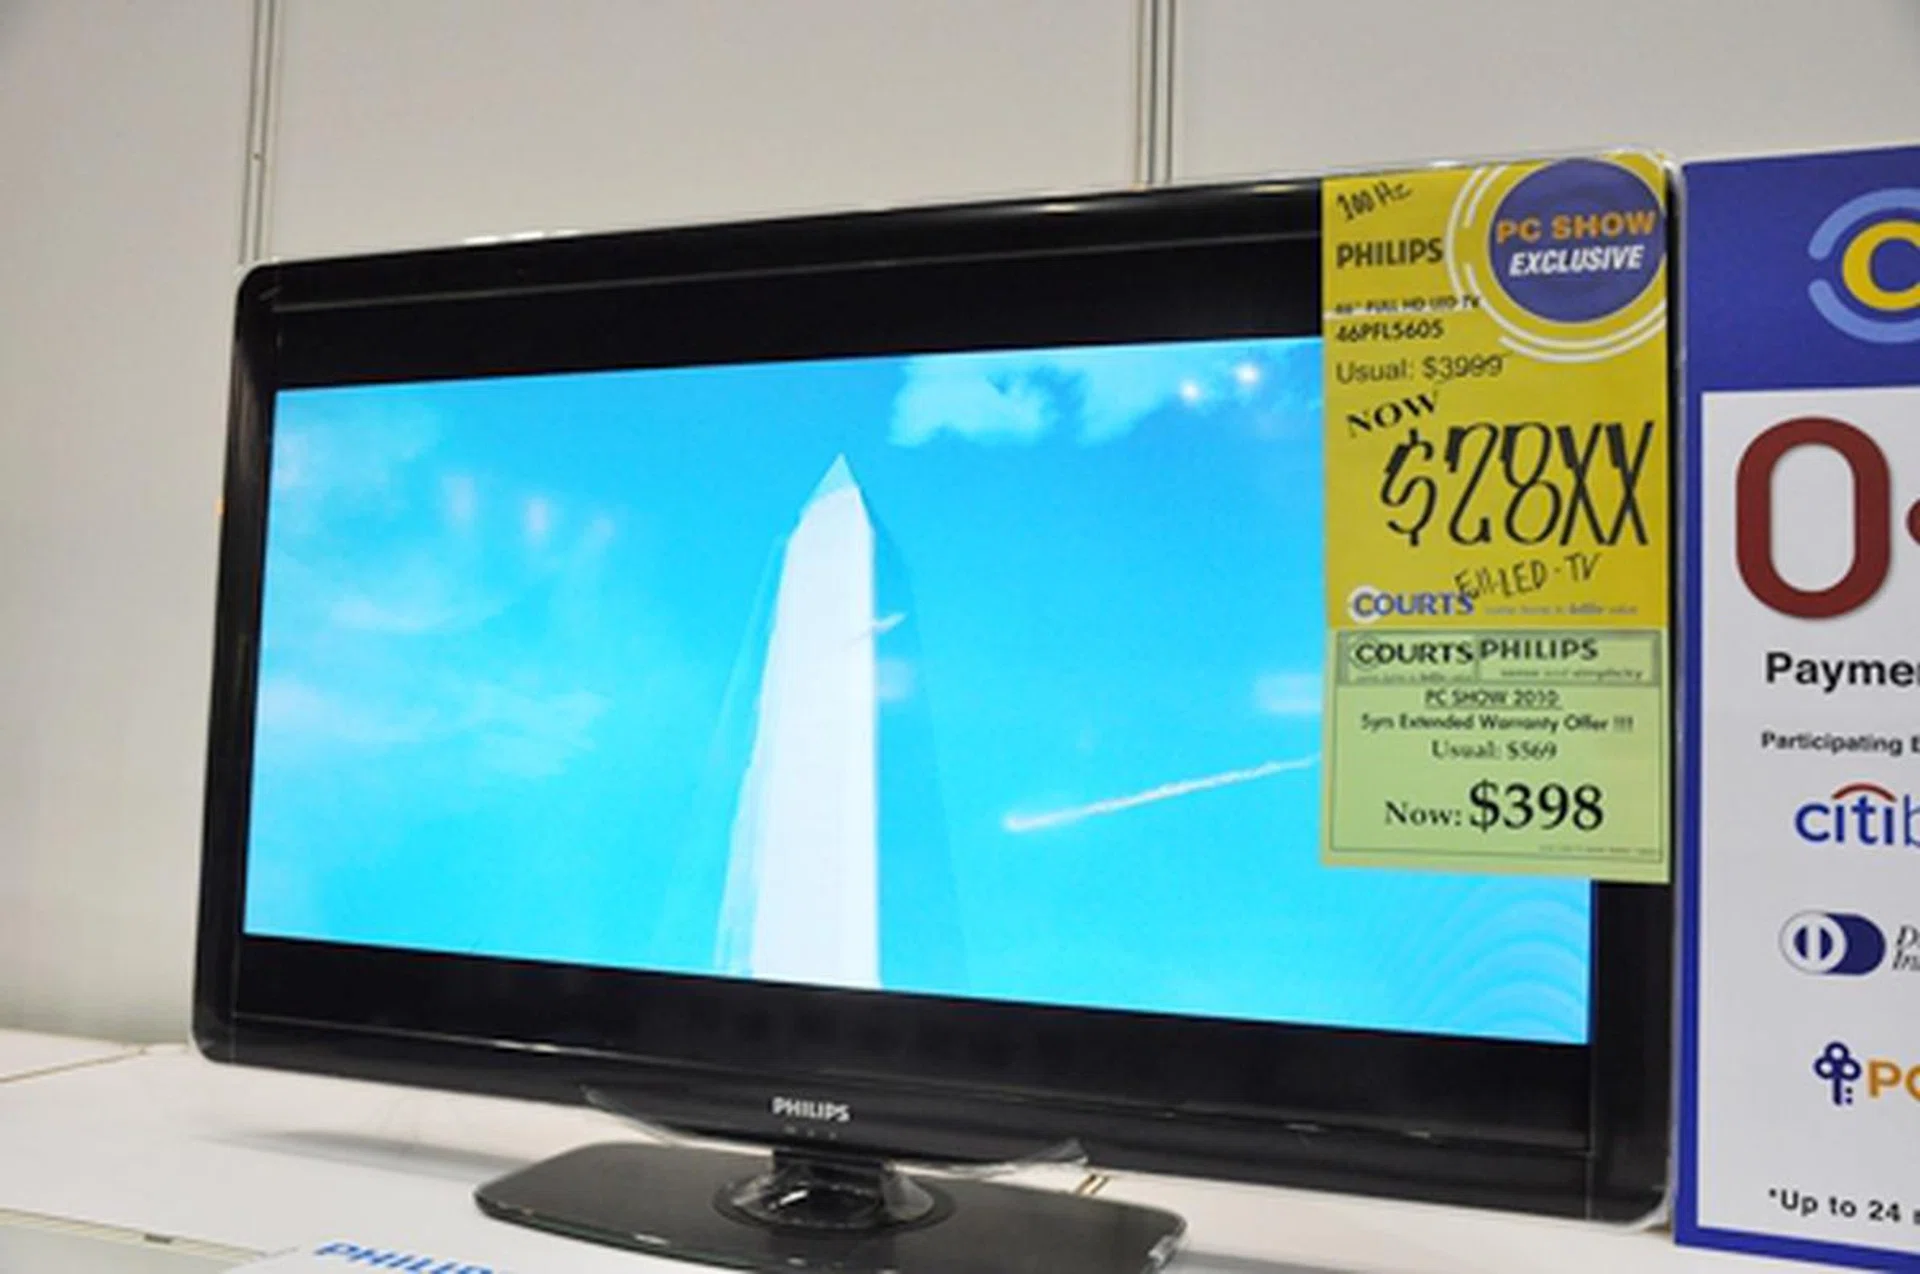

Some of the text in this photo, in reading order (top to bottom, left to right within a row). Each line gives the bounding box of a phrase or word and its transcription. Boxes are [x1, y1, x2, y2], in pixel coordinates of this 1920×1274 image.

[1496, 210, 1657, 243] PC SHOW
[1336, 237, 1444, 268] PHILIPS
[1509, 245, 1645, 277] EXCLUSIVE
[1335, 361, 1415, 384] Usual:
[1347, 390, 1438, 437] NOW
[1348, 587, 1475, 617] COURTS
[1355, 637, 1599, 665] COURTS PHILIPS
[1765, 651, 1920, 694] Payme
[1451, 689, 1508, 706] SHOW
[1400, 713, 1474, 730] Extended
[1479, 715, 1559, 733] Warranty
[1563, 713, 1609, 731] Offer
[1761, 732, 1903, 757] Participating
[1385, 778, 1604, 833] Now: $398
[772, 1097, 850, 1122] PHILIPS
[1829, 1196, 1857, 1218] to
[1868, 1199, 1901, 1223] 24
[315, 1242, 495, 1274] PHILIP
